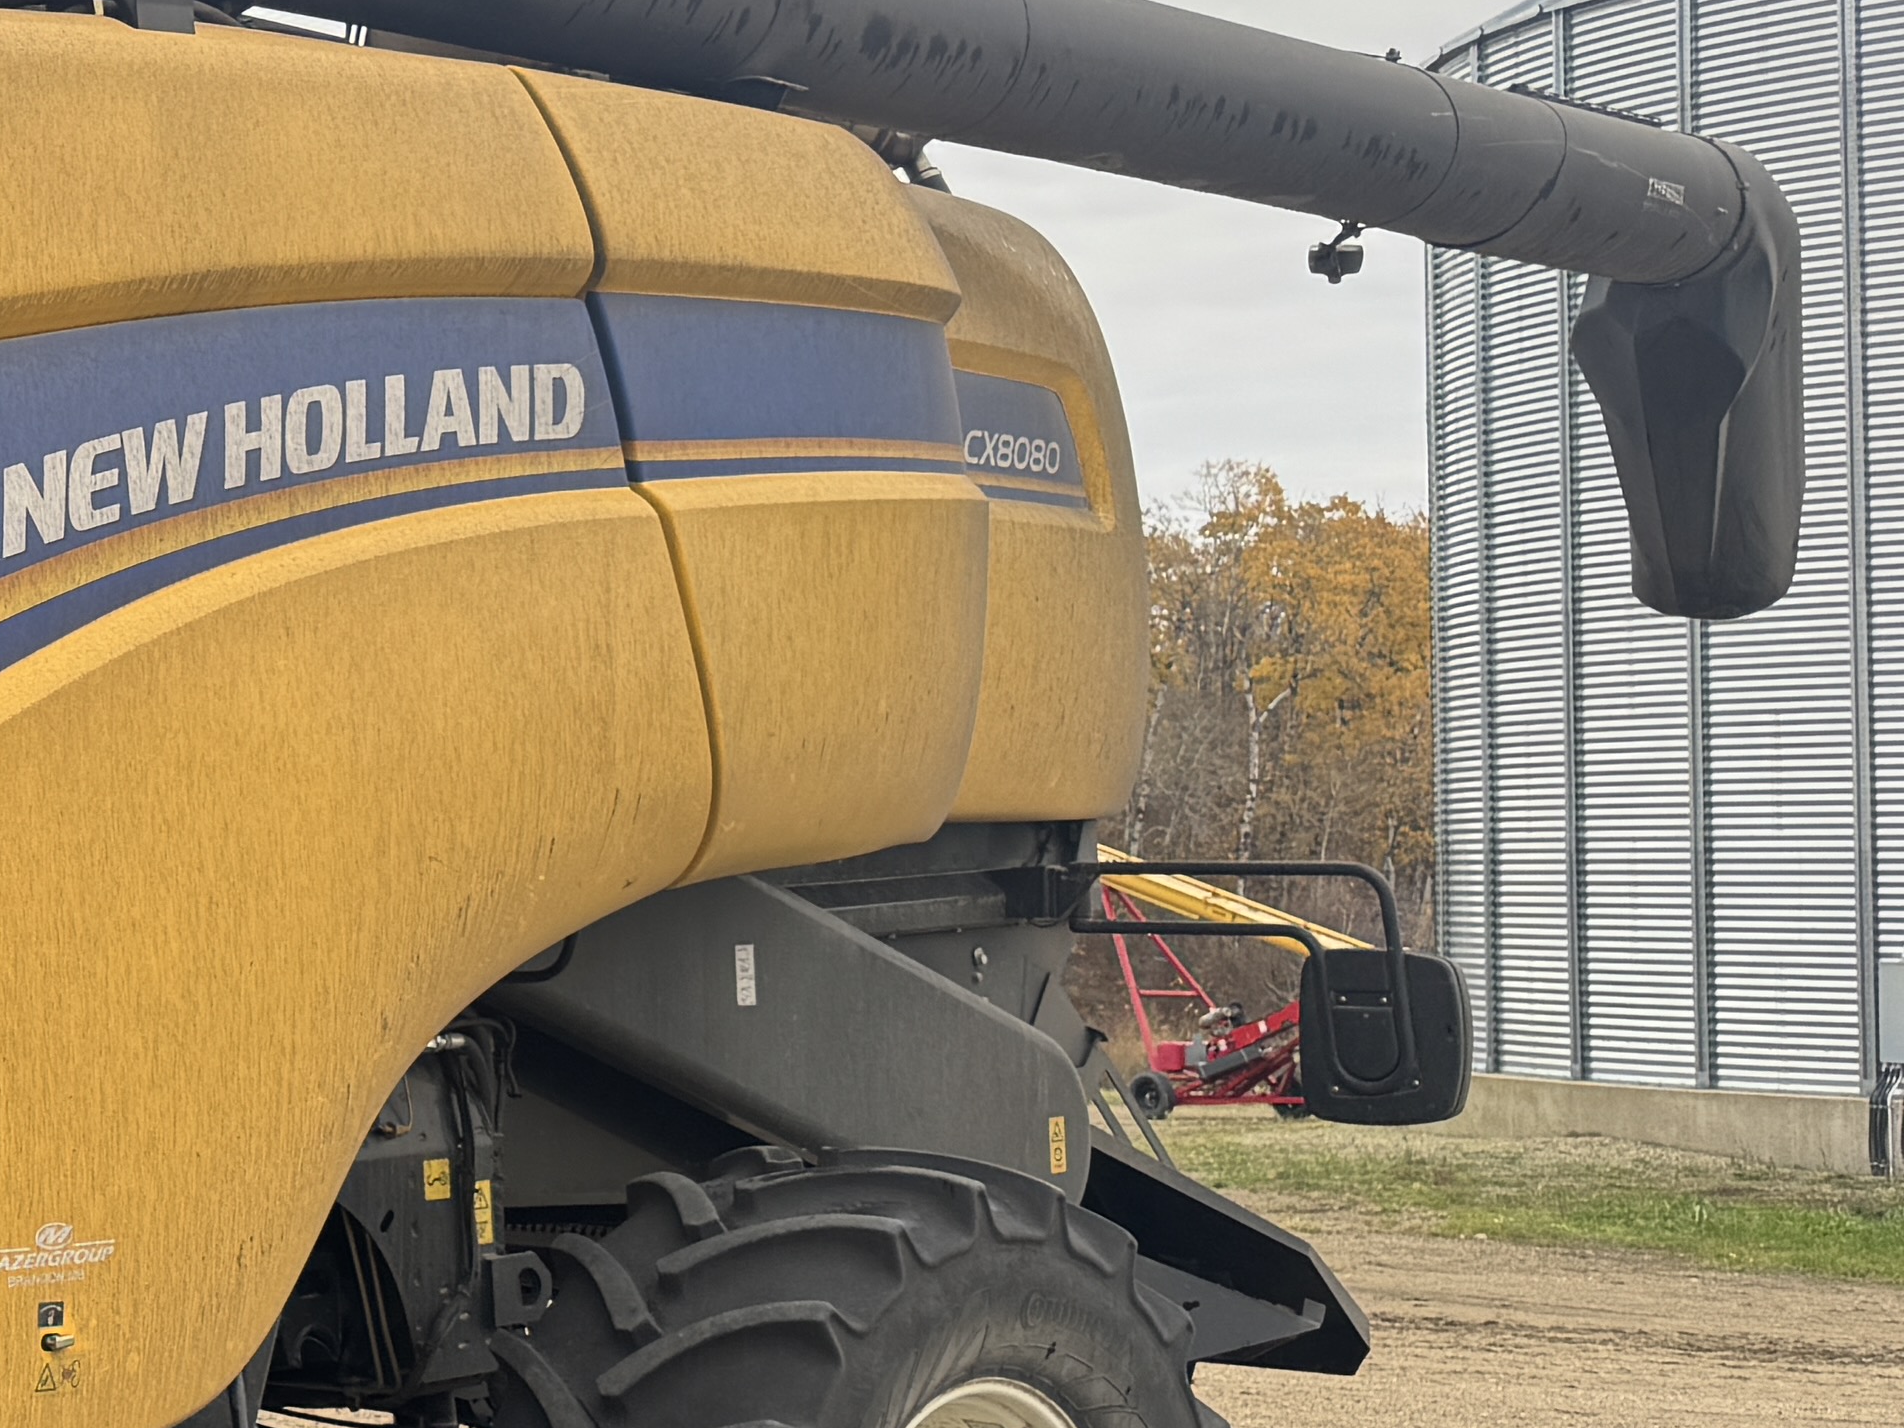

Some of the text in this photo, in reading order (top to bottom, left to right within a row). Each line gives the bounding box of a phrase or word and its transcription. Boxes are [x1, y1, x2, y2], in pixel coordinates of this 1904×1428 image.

[1, 362, 586, 558] NEW HOLLAND
[963, 429, 1060, 475] CX8080
